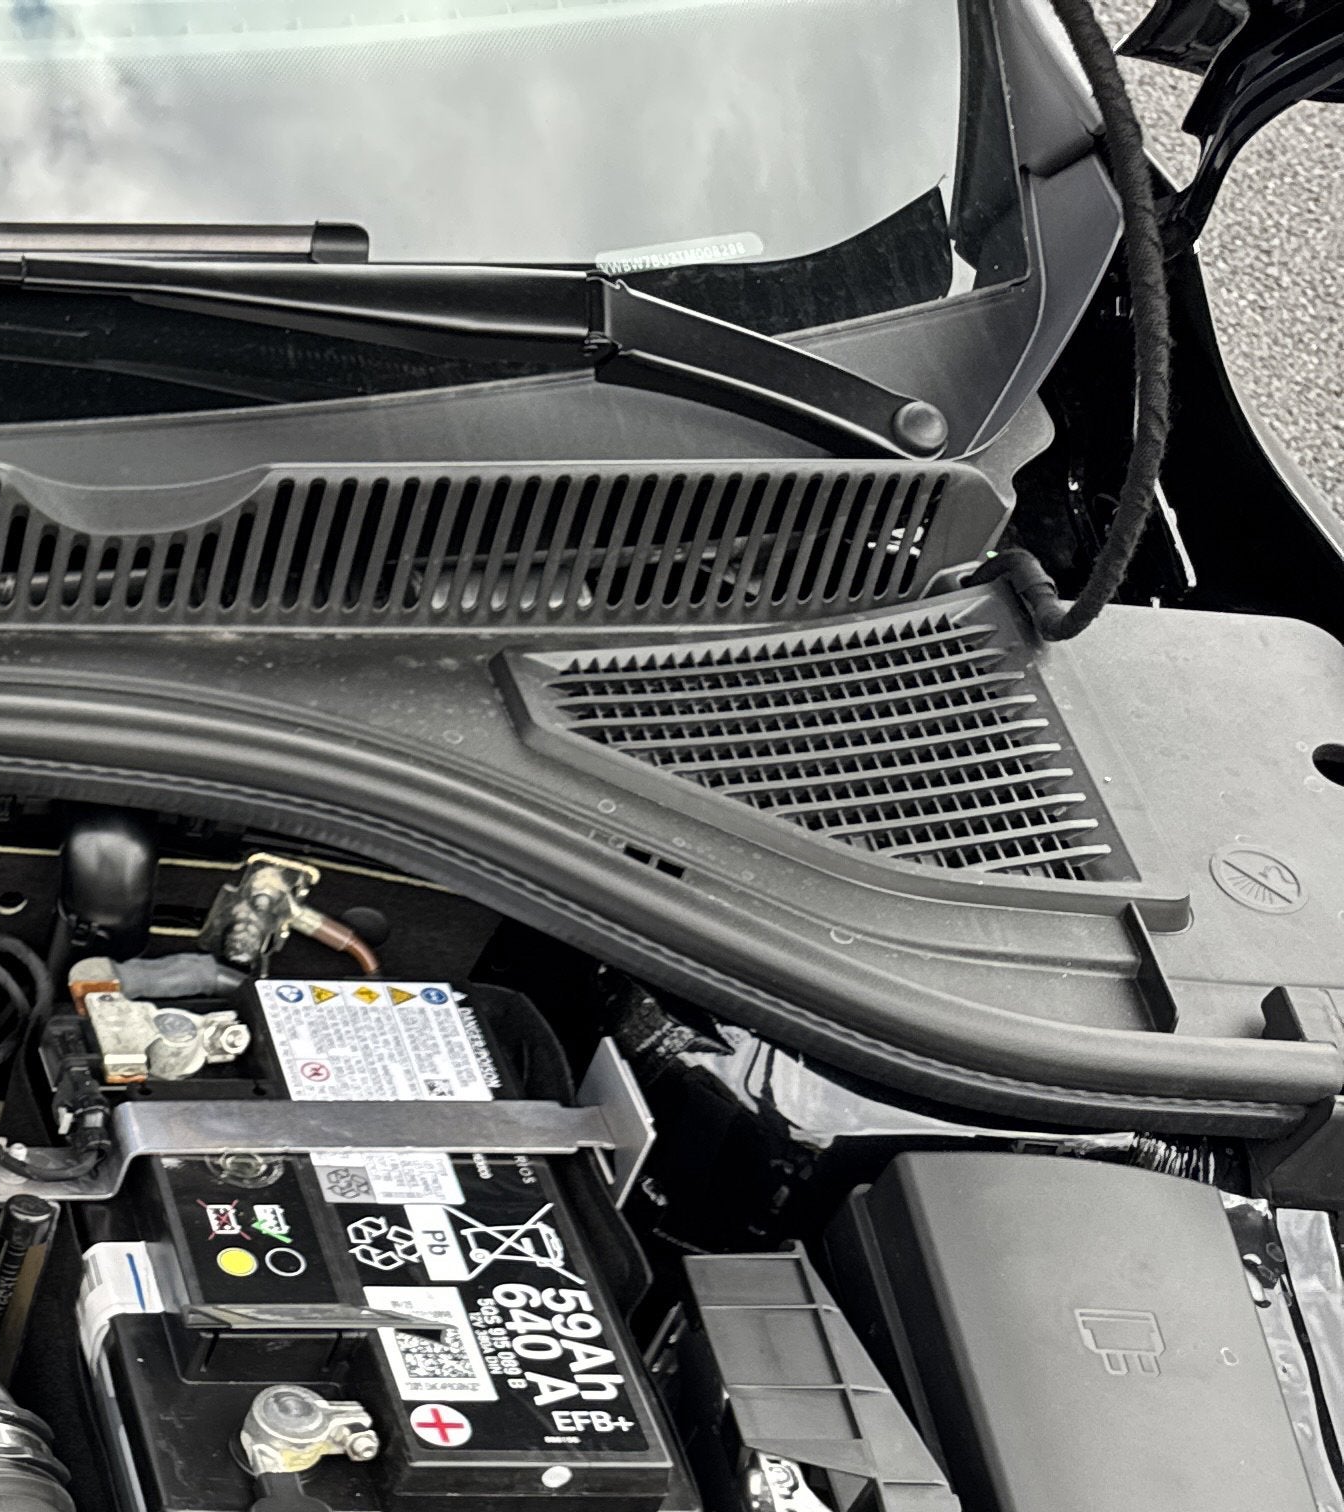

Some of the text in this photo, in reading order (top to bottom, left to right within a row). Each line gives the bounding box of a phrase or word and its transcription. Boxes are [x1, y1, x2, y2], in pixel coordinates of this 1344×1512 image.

[422, 1227, 449, 1257] Pb
[492, 1283, 565, 1359] 640
[541, 1287, 625, 1402] 59Ah
[524, 1361, 581, 1406] A
[550, 1408, 635, 1435] EFB+
